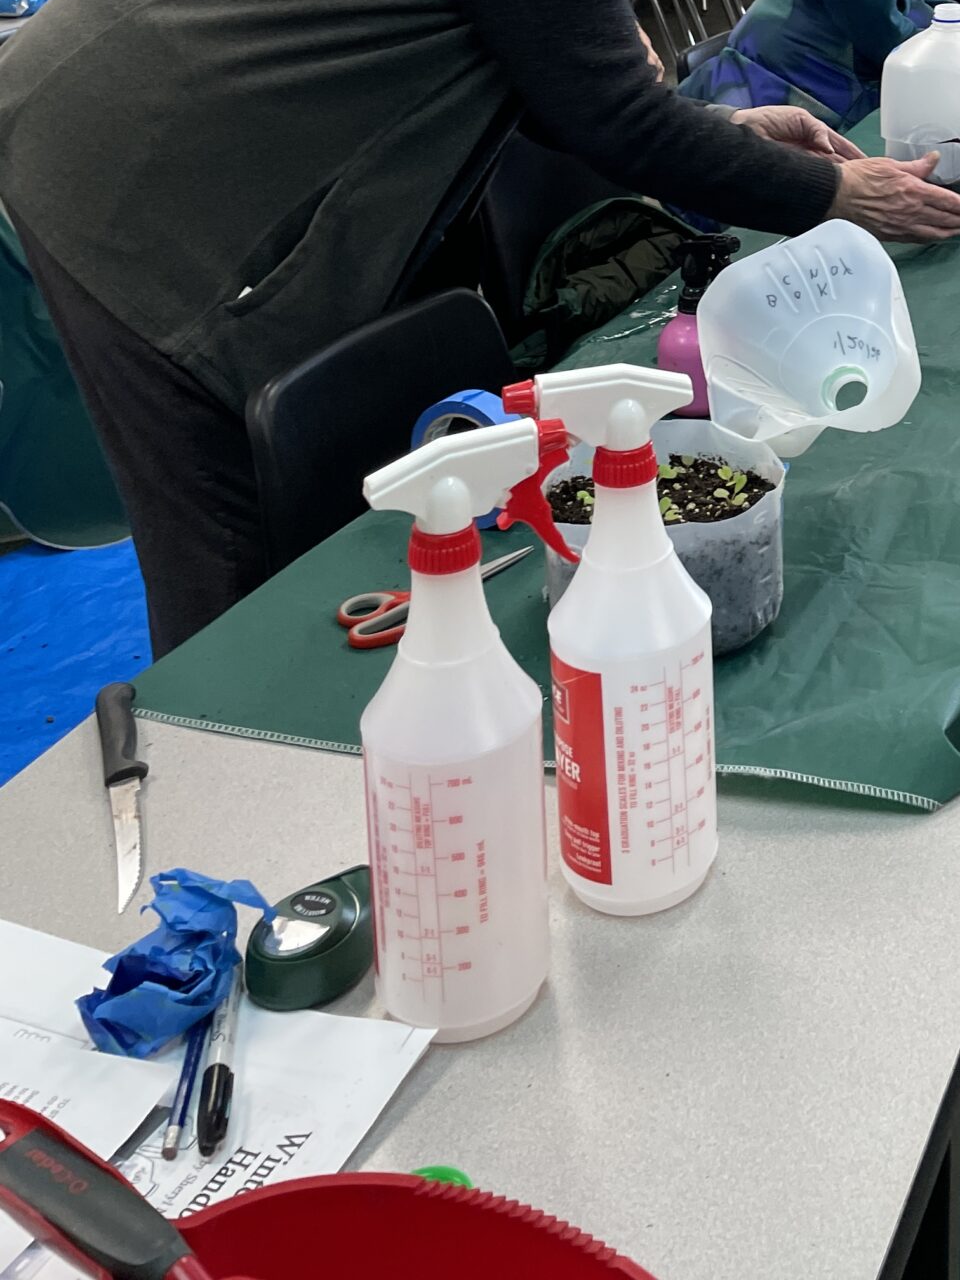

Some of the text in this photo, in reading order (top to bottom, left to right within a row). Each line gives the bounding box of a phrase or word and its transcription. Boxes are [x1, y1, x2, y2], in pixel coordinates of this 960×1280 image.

[614, 706, 624, 735] DILUTING
[615, 735, 625, 749] AND
[616, 750, 625, 772] MIXING
[618, 787, 628, 810] SCALES
[620, 810, 629, 849] GRADUATION
[478, 877, 487, 896] RING
[304, 895, 332, 905] METER
[480, 896, 488, 913] FILL
[480, 912, 488, 924] TO
[162, 1170, 201, 1207] Sheryl
